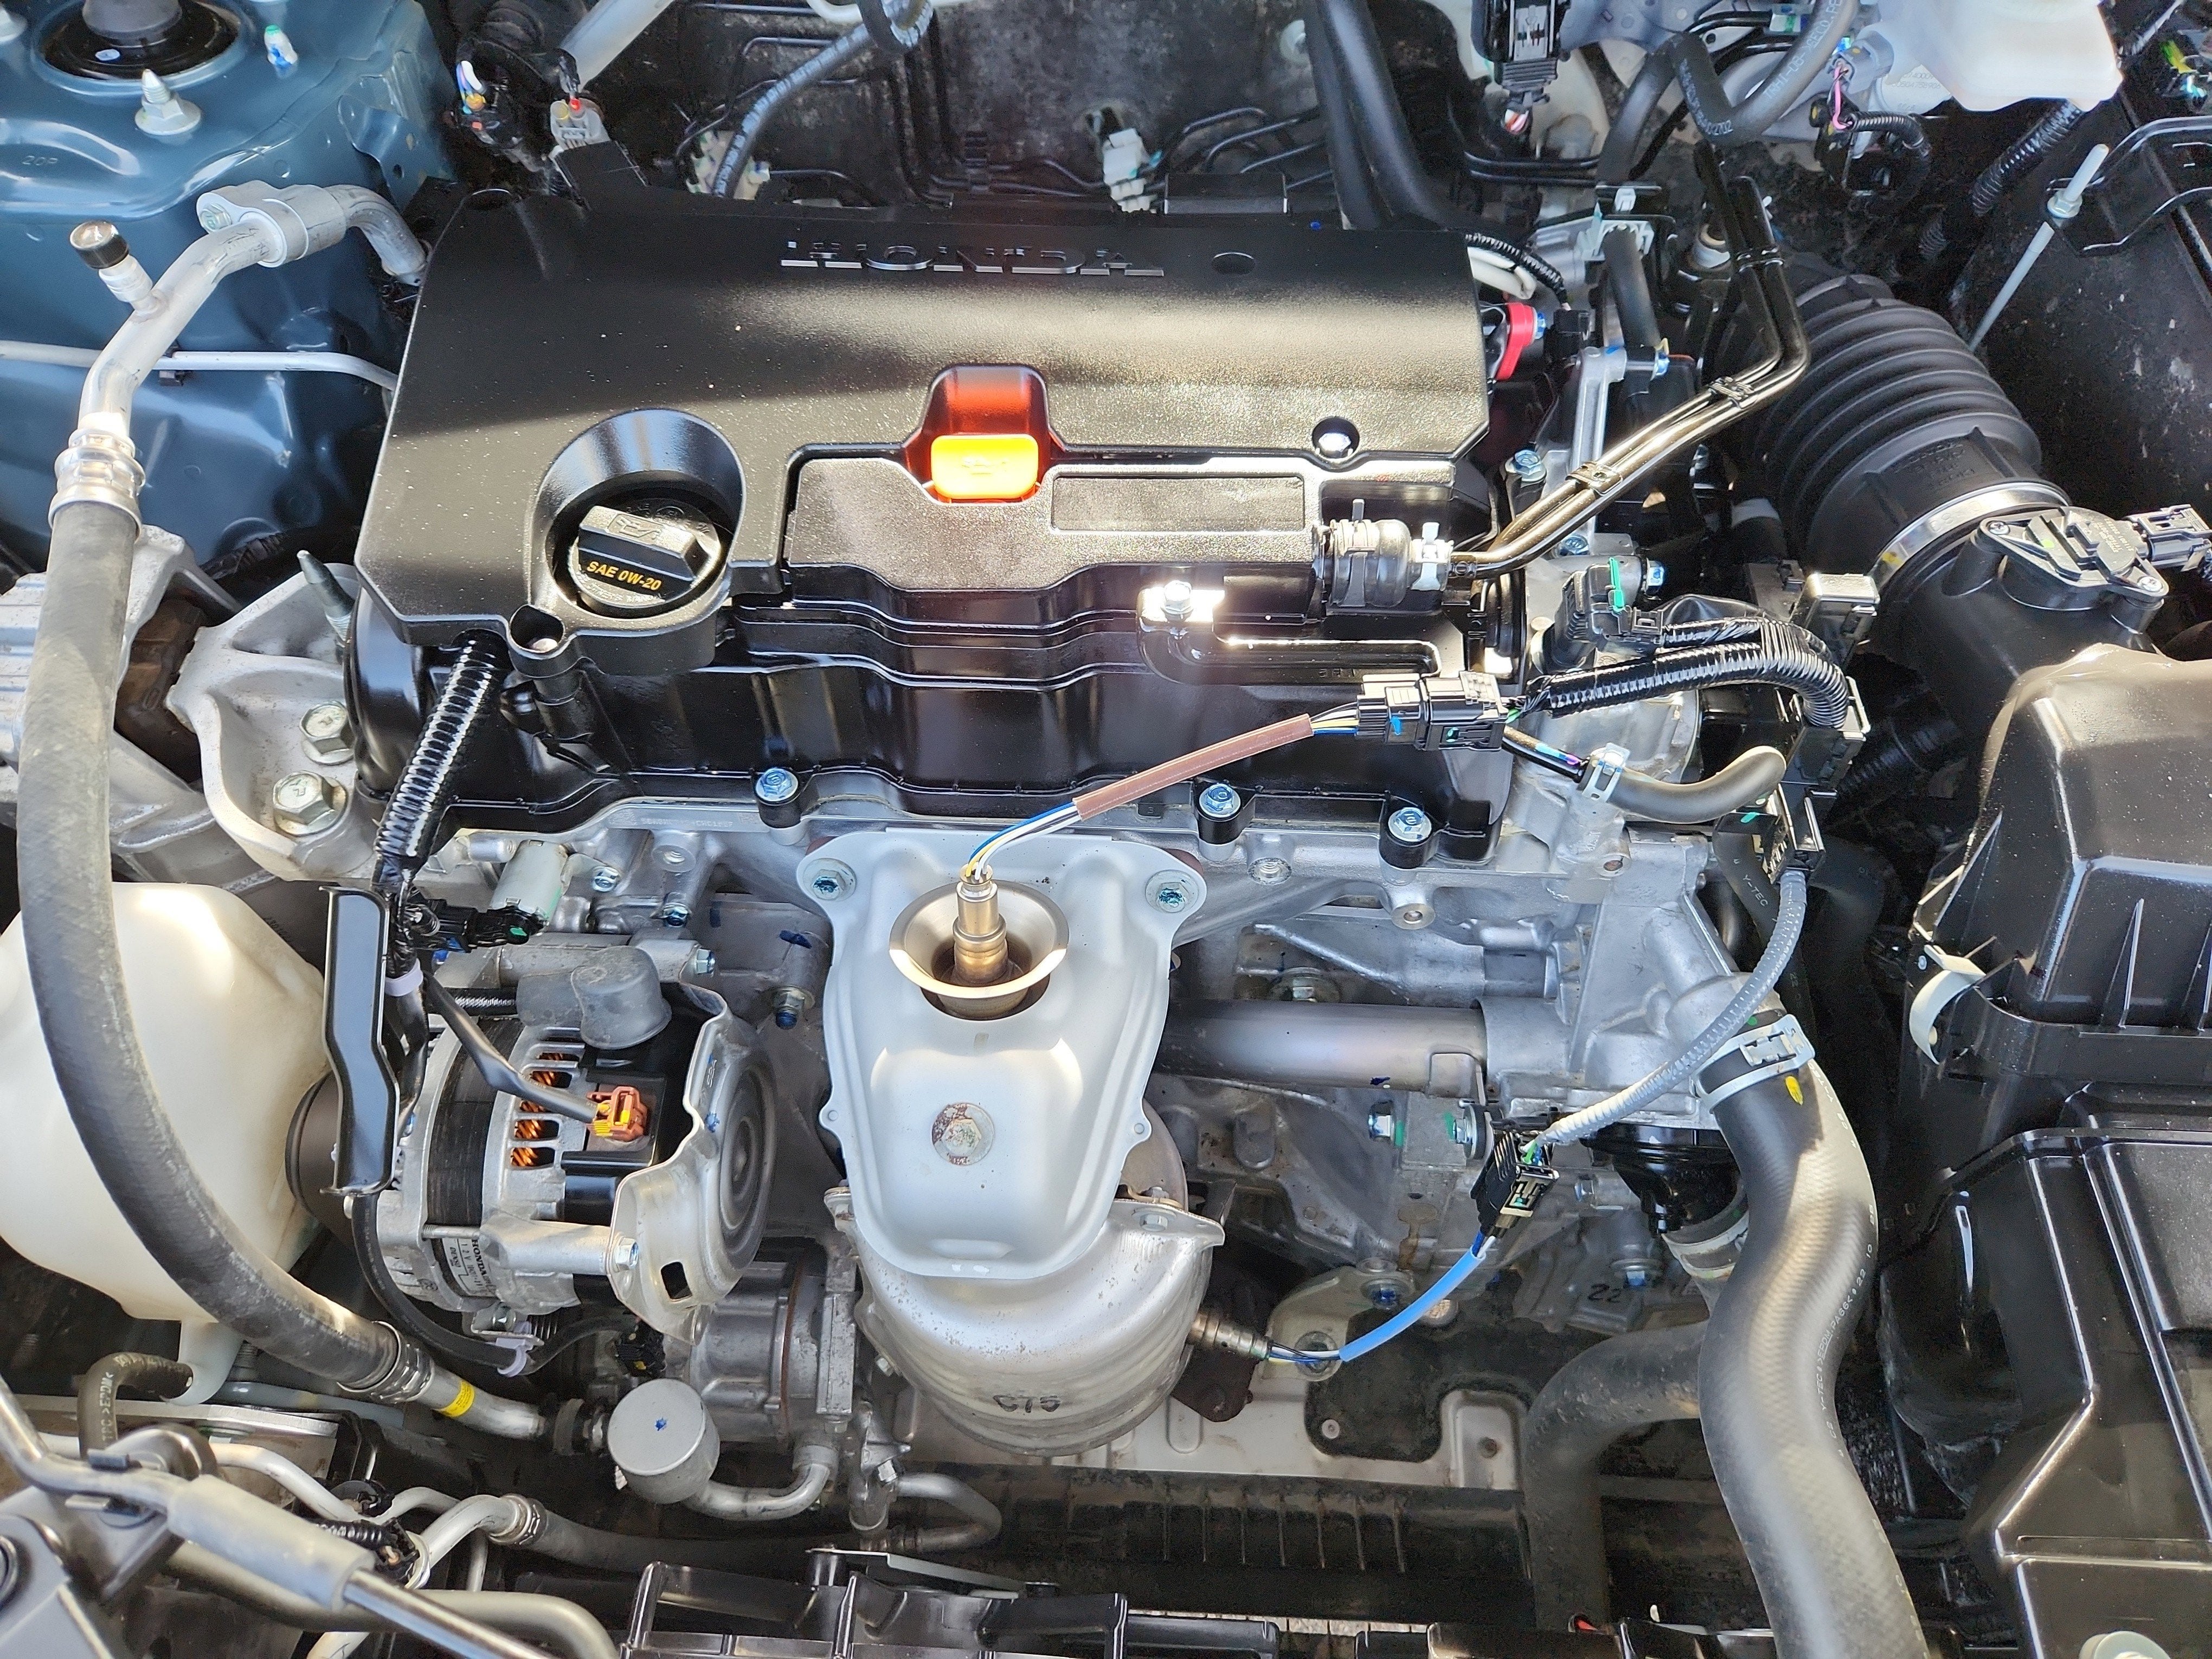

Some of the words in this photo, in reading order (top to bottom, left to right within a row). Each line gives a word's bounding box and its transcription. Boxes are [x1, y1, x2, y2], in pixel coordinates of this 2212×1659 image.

[781, 240, 1165, 276] HONDA
[587, 561, 619, 577] SAE
[618, 569, 662, 591] 0W-20
[1743, 874, 1768, 907] Y-TEC
[471, 1238, 487, 1276] HONDA
[1816, 1373, 1827, 1411] Y-TEC
[1856, 1269, 1867, 1287] 22
